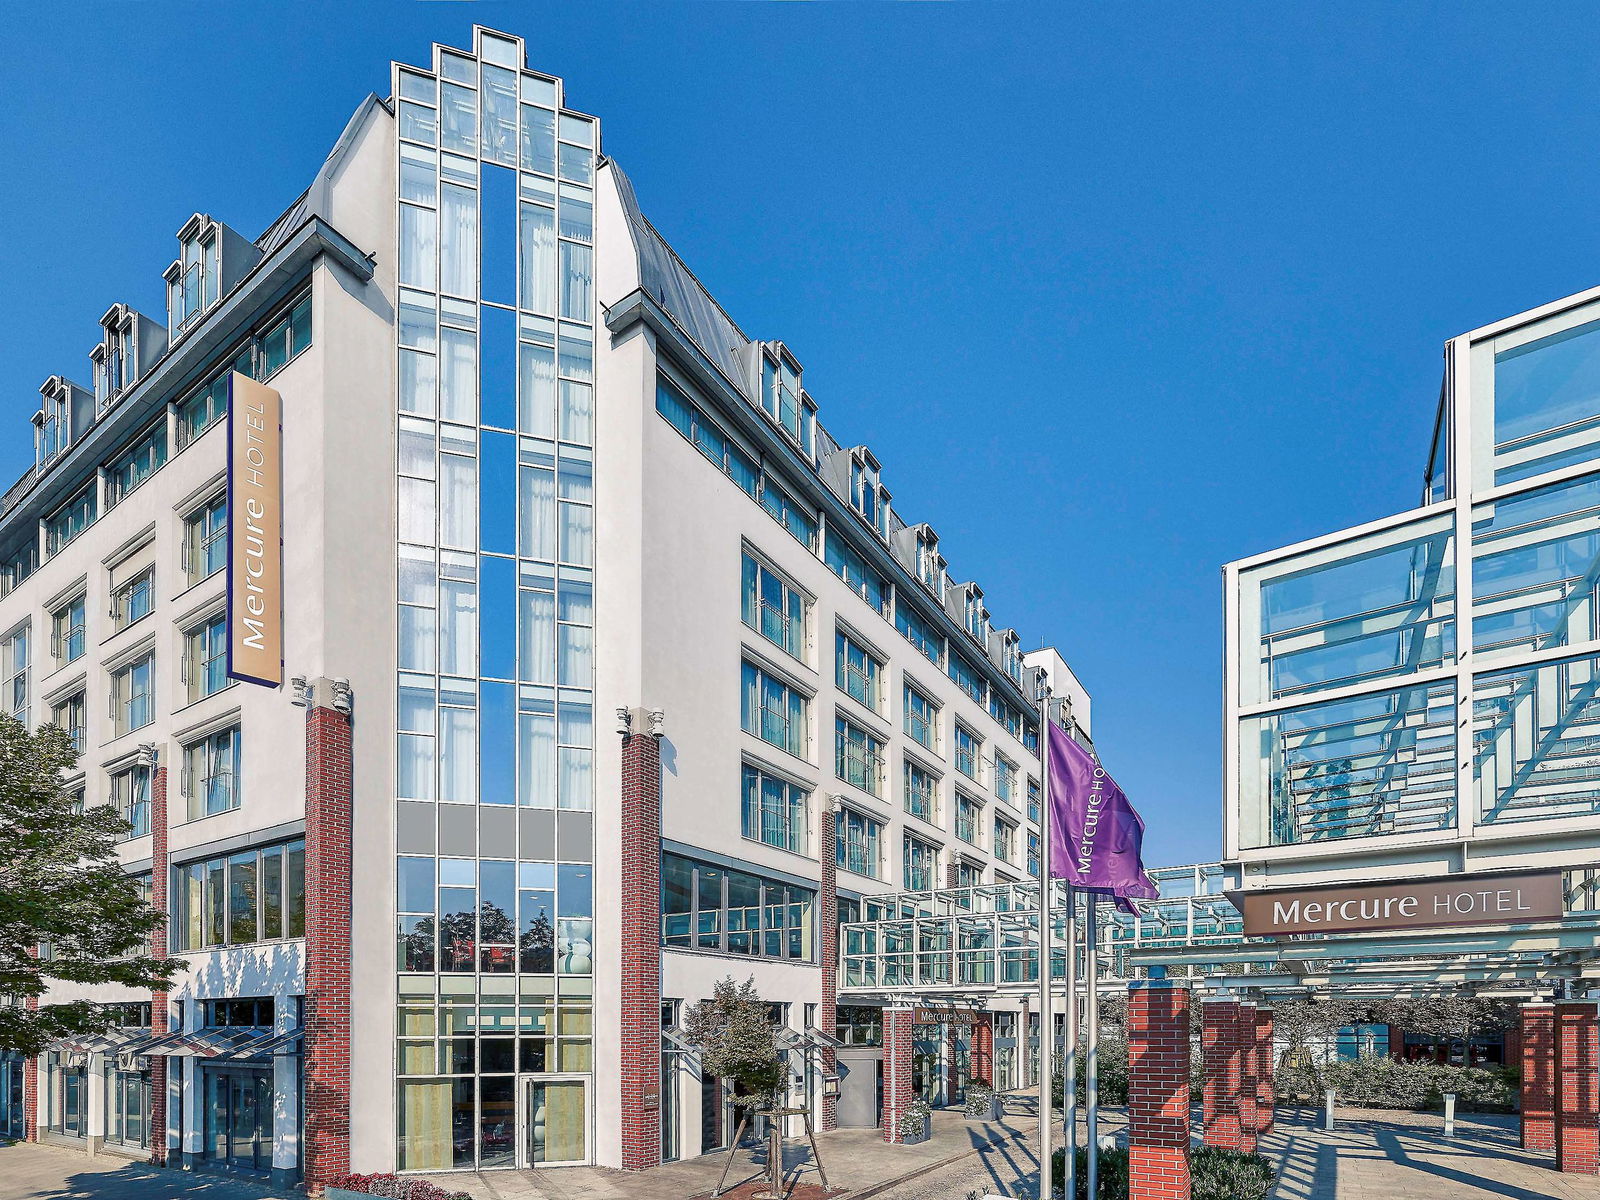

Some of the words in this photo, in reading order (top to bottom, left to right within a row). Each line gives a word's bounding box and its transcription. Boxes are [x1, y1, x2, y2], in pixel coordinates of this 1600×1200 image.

[246, 403, 265, 488] HOTEL
[242, 498, 265, 650] Mercure
[1077, 793, 1102, 874] Mercure
[1273, 895, 1419, 925] Mercure
[1433, 889, 1531, 915] HOTEL
[921, 1011, 953, 1022] Mercure
